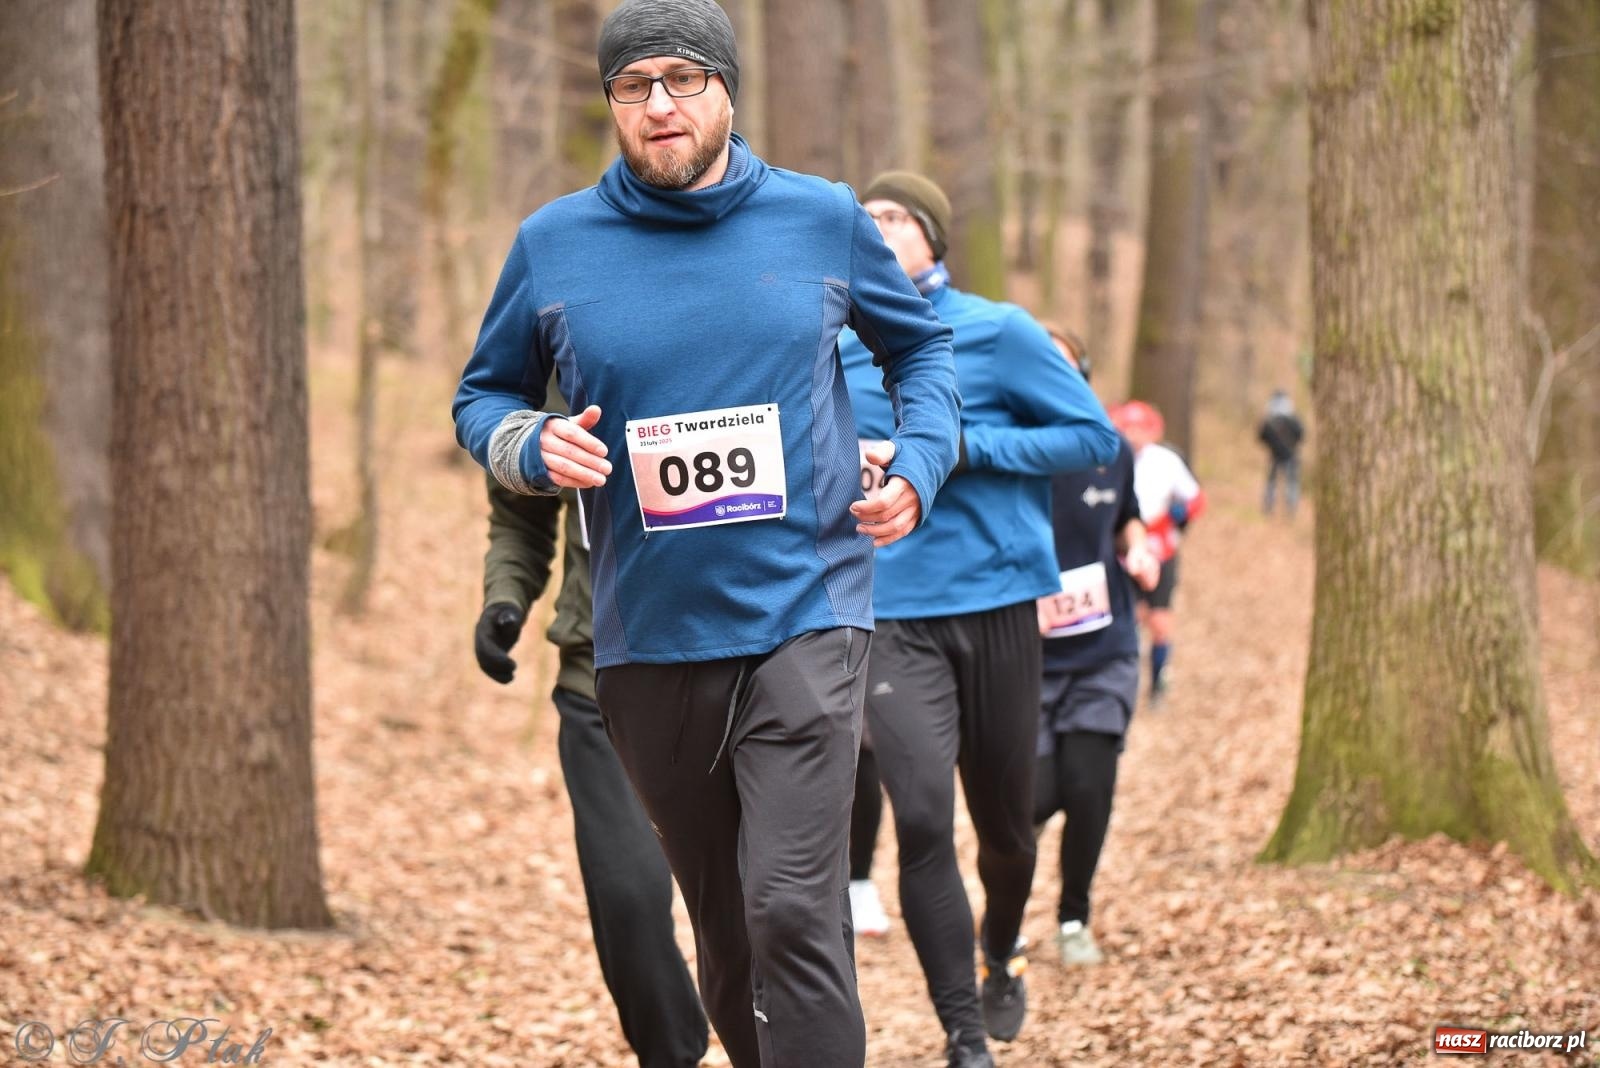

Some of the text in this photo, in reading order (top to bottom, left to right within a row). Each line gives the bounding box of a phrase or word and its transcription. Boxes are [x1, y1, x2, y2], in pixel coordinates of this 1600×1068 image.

[637, 412, 765, 438] BIEG Twardziela
[659, 447, 756, 496] 089
[726, 503, 762, 512] Racibórz
